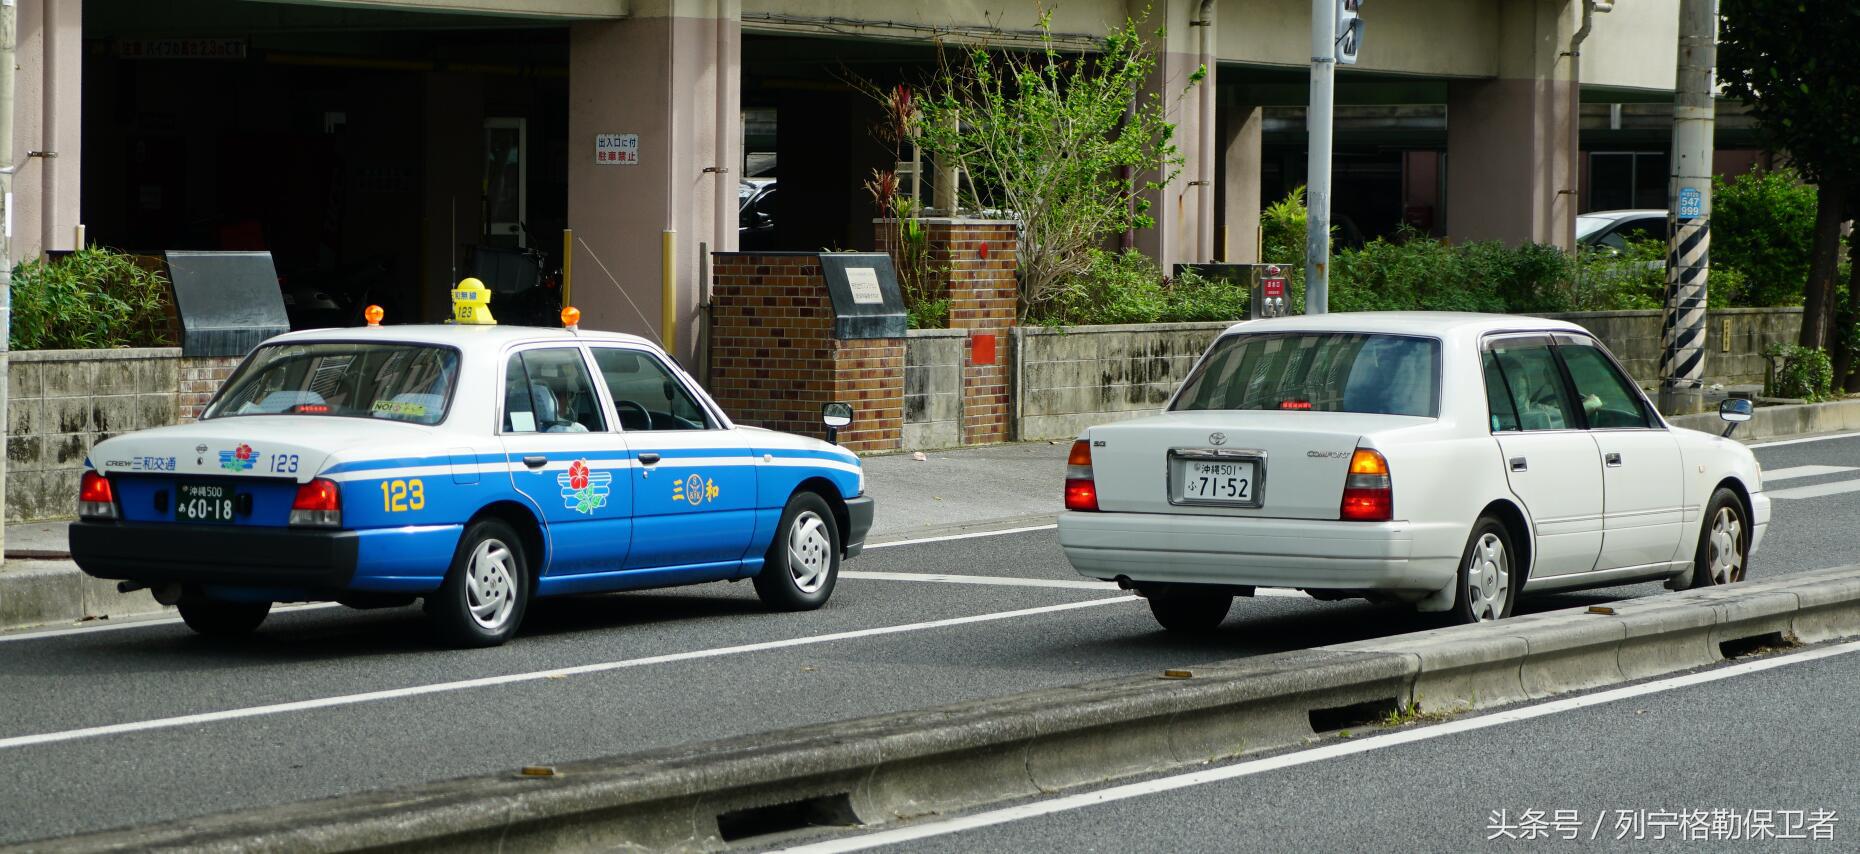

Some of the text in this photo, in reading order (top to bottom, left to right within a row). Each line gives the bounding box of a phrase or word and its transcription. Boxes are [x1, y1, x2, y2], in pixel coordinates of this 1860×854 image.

[598, 137, 636, 148] 出入口に付
[598, 151, 636, 161] 駐車禁止
[1681, 197, 1699, 207] 547
[458, 306, 473, 318] 123
[105, 459, 132, 467] CREW
[131, 456, 176, 471] 三和交通
[270, 453, 299, 473] 123
[1188, 476, 1249, 498] ふ 71-52
[381, 478, 425, 513] 123
[178, 498, 232, 520] あ 60-18
